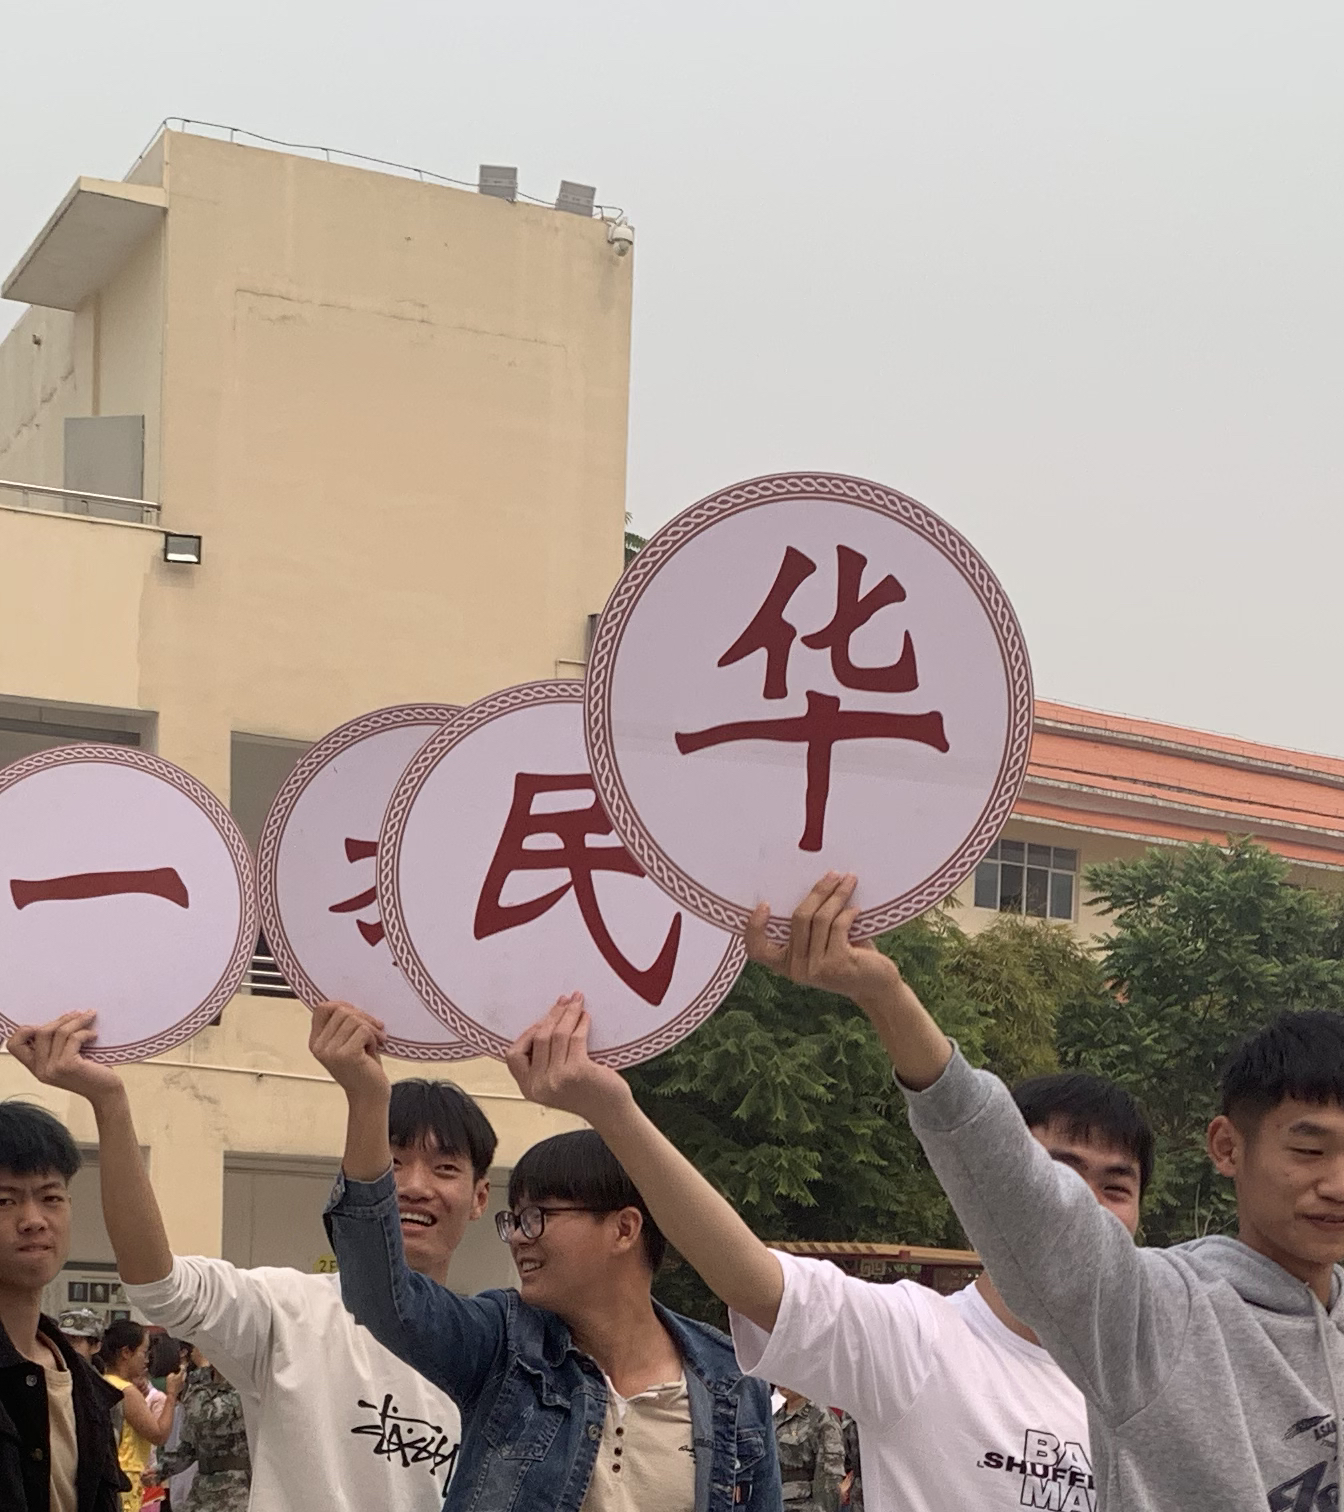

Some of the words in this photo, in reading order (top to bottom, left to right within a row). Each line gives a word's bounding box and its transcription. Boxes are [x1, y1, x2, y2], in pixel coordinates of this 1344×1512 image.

[674, 544, 950, 853] 华
[9, 866, 190, 911] 一
[473, 771, 683, 1007] 民
